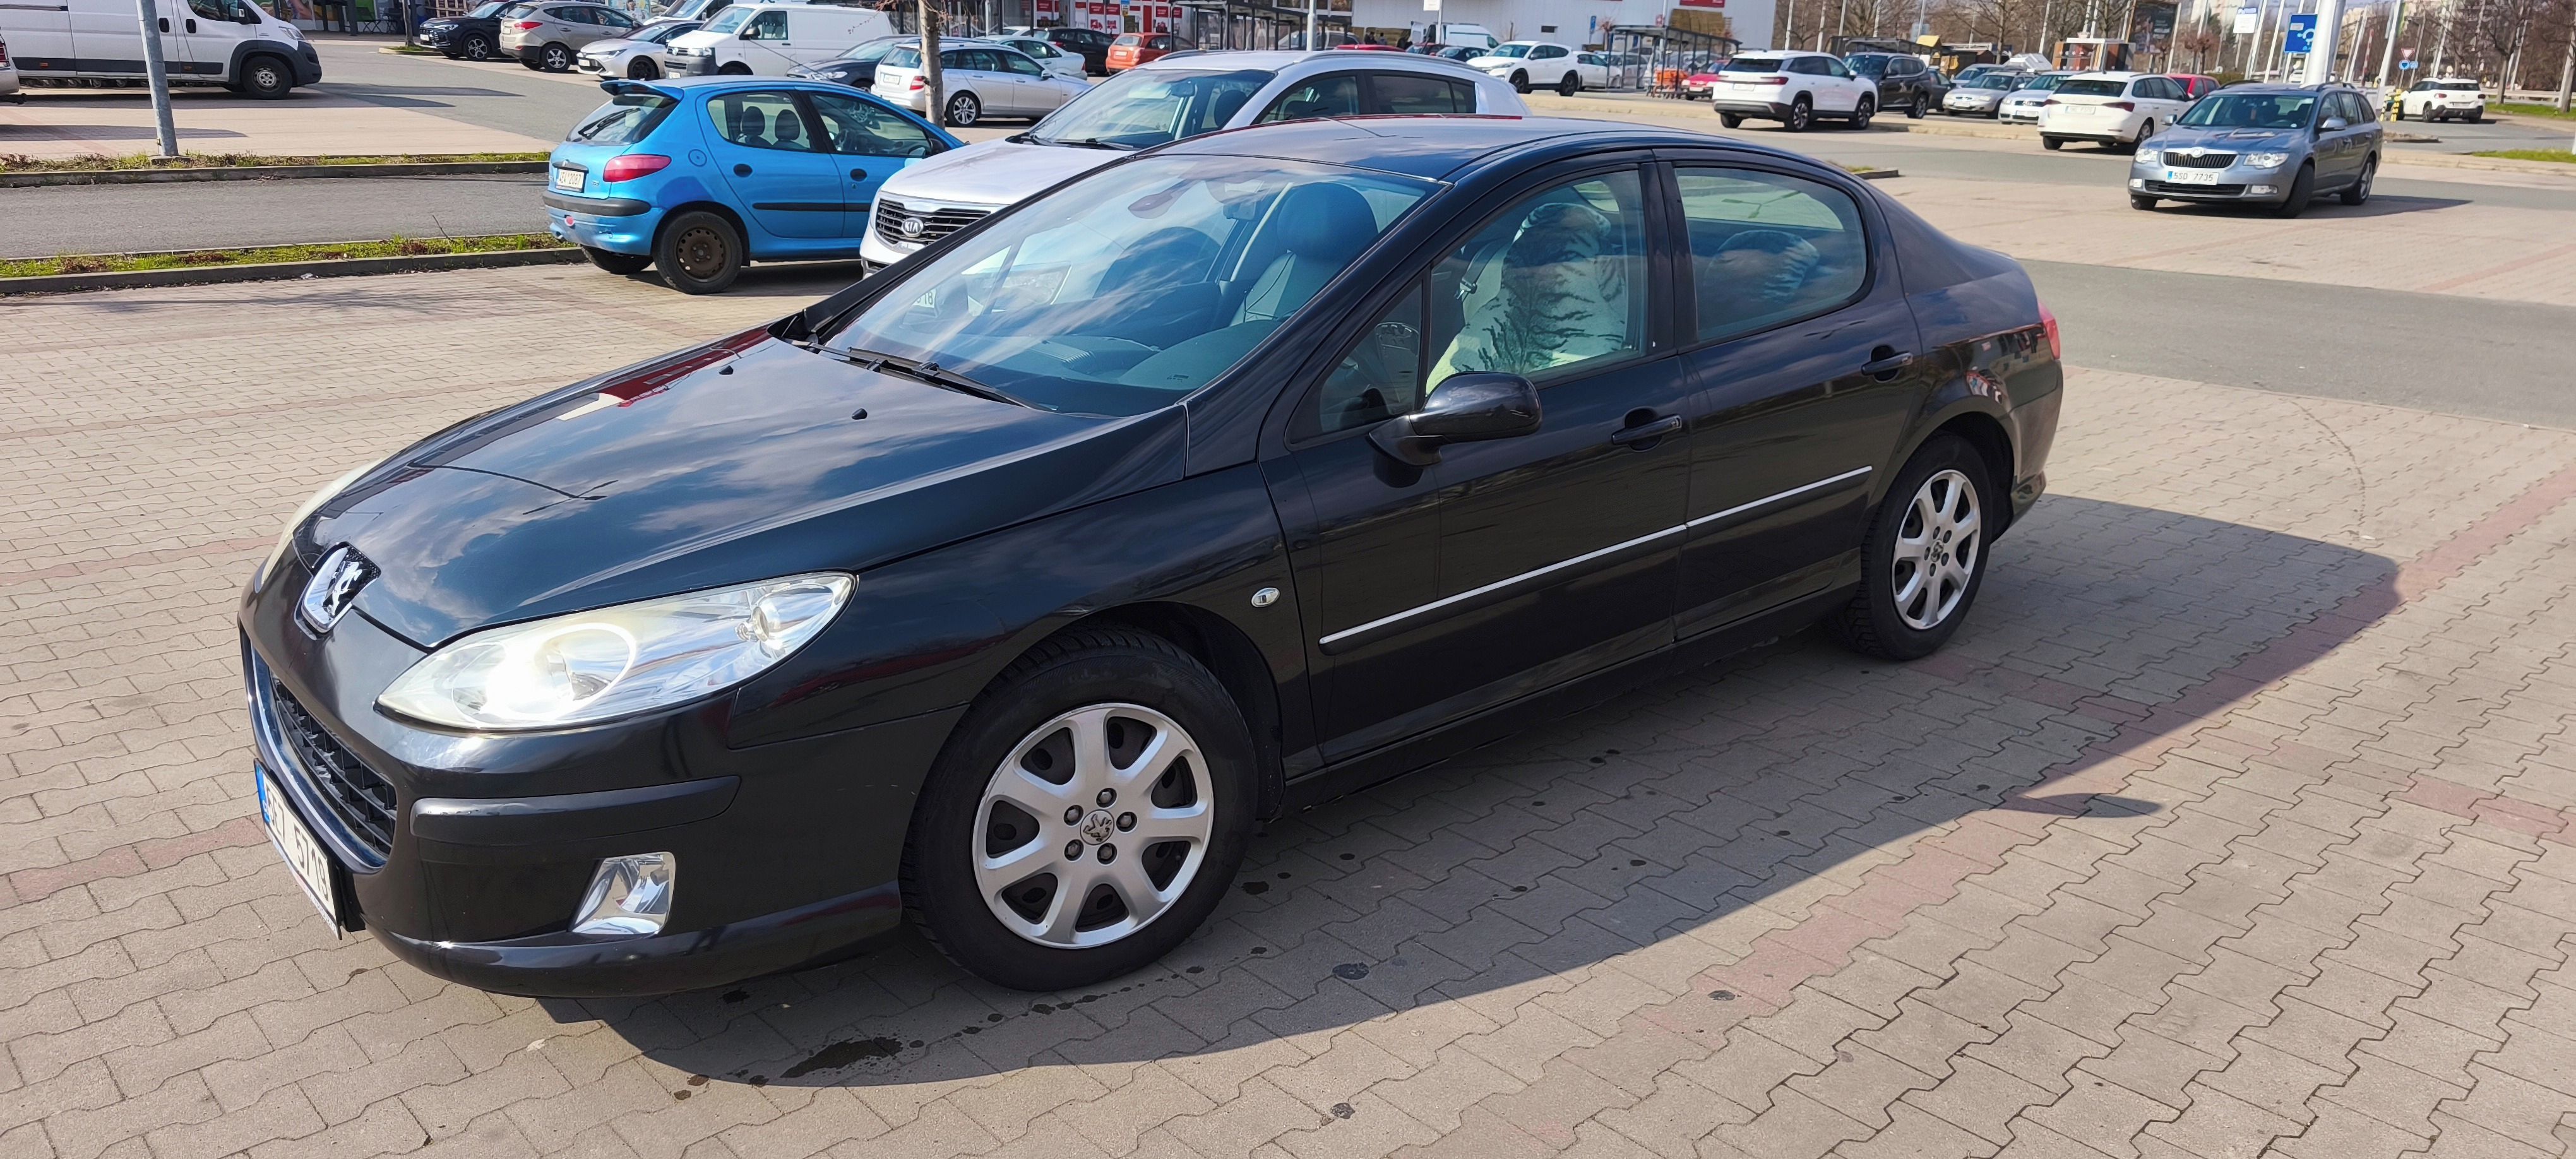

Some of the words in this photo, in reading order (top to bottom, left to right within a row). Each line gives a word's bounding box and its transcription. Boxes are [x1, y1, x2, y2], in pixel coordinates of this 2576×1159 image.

[2193, 173, 2214, 181] 7735
[905, 221, 918, 233] KIA
[294, 823, 329, 902] 5719
